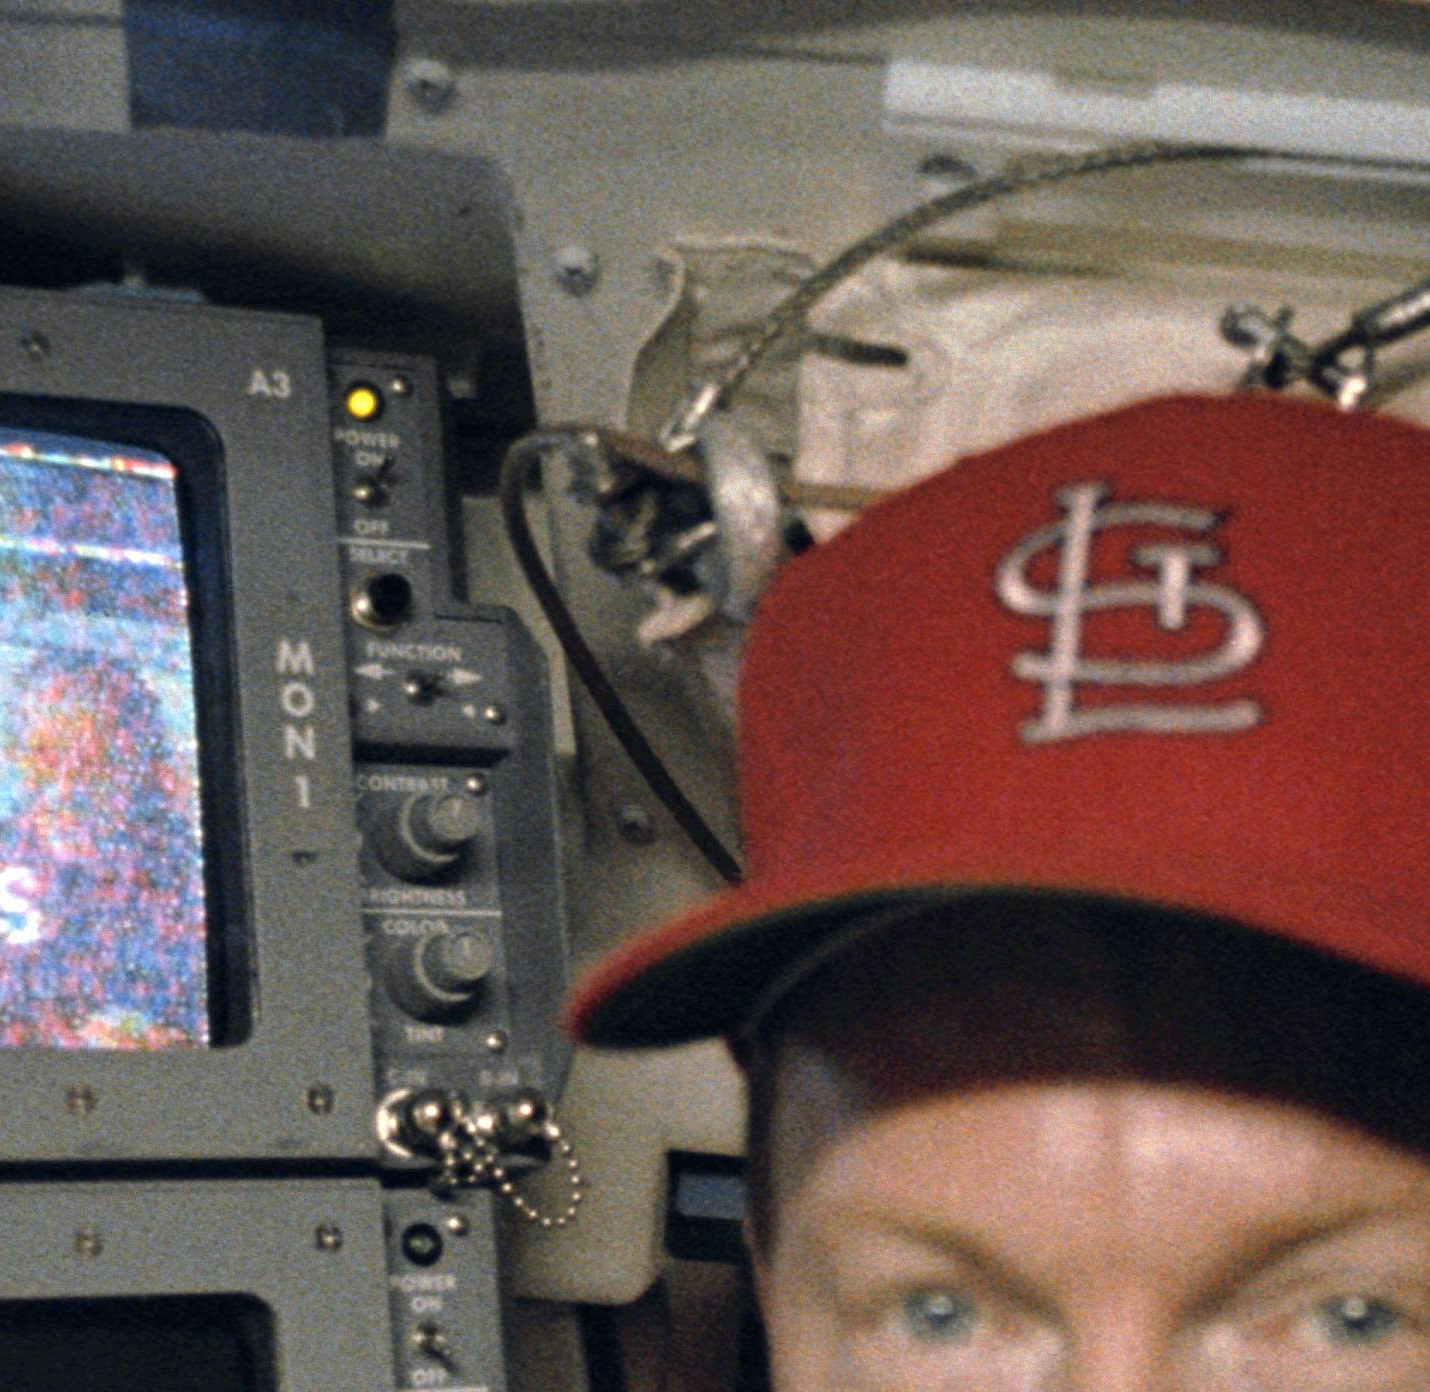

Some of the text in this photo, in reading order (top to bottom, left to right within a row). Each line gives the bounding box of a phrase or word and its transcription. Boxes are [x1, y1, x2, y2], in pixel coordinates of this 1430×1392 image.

[246, 368, 292, 399] A3
[355, 450, 386, 467] ON
[352, 518, 390, 536] OFF
[349, 546, 408, 565] SELECT
[366, 641, 462, 663] FUNCTION
[275, 639, 317, 809] MON 1
[365, 887, 467, 907] RIGHTNESS
[410, 1296, 443, 1314] ON
